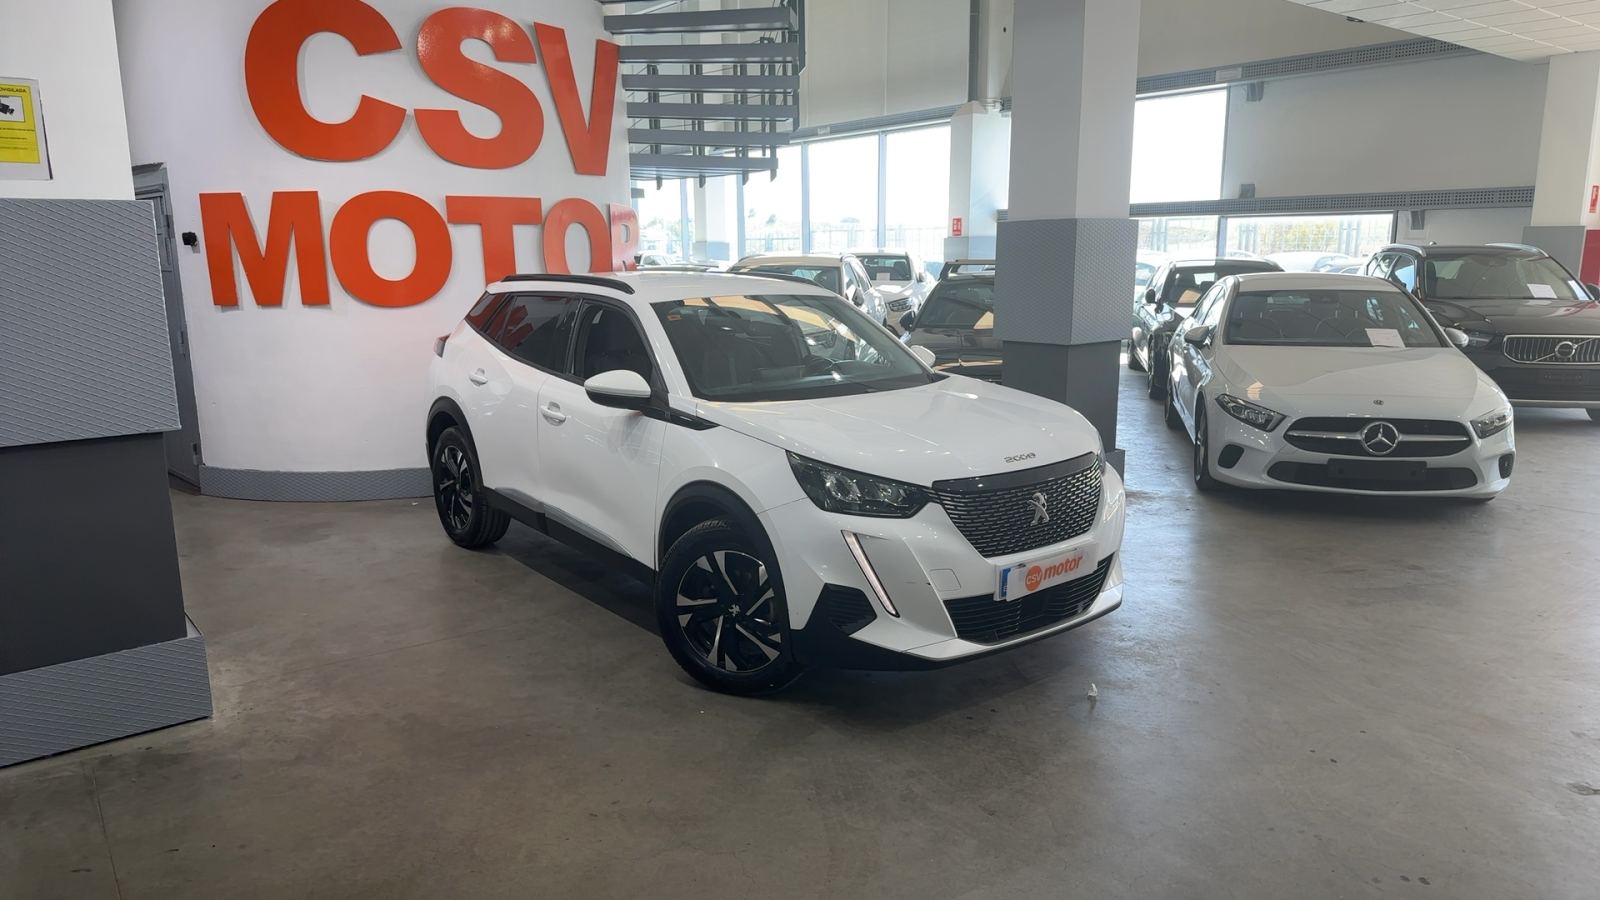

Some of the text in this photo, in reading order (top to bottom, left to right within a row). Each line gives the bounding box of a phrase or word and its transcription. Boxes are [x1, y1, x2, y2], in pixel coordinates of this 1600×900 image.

[245, 0, 620, 176] CSV
[199, 190, 639, 307] MOTOR
[1003, 452, 1036, 463] 2008
[1044, 555, 1083, 580] motor
